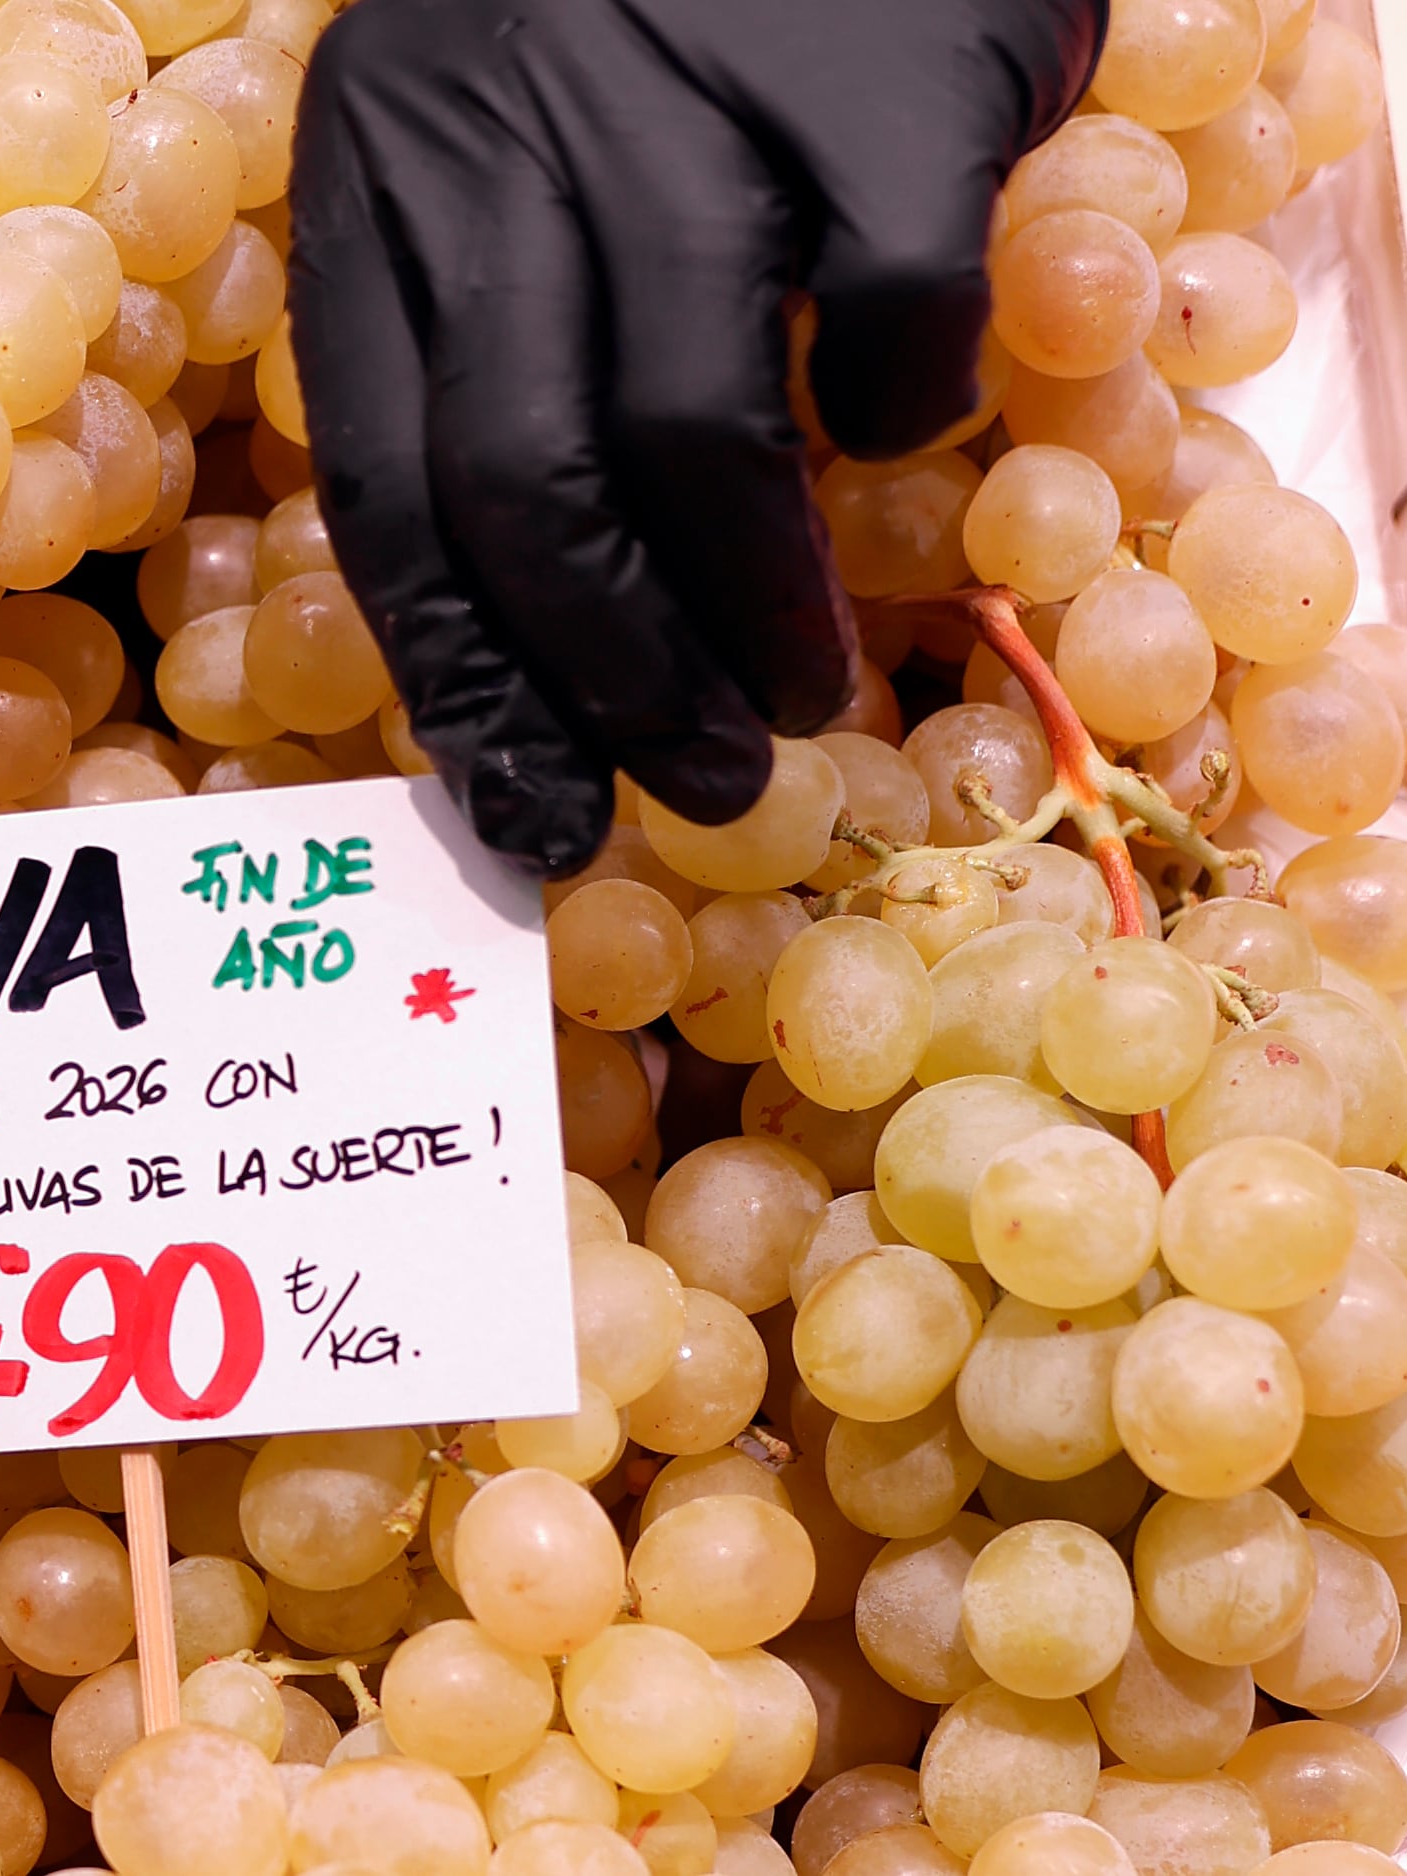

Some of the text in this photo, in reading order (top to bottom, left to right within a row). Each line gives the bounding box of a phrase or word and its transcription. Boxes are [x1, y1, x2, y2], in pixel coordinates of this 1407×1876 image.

[182, 837, 374, 912] FIN DE
[212, 920, 355, 991] AÑO
[44, 1058, 168, 1121] 2026
[205, 1053, 299, 1110] CON
[127, 1154, 186, 1203] DE
[217, 1147, 268, 1197] LA
